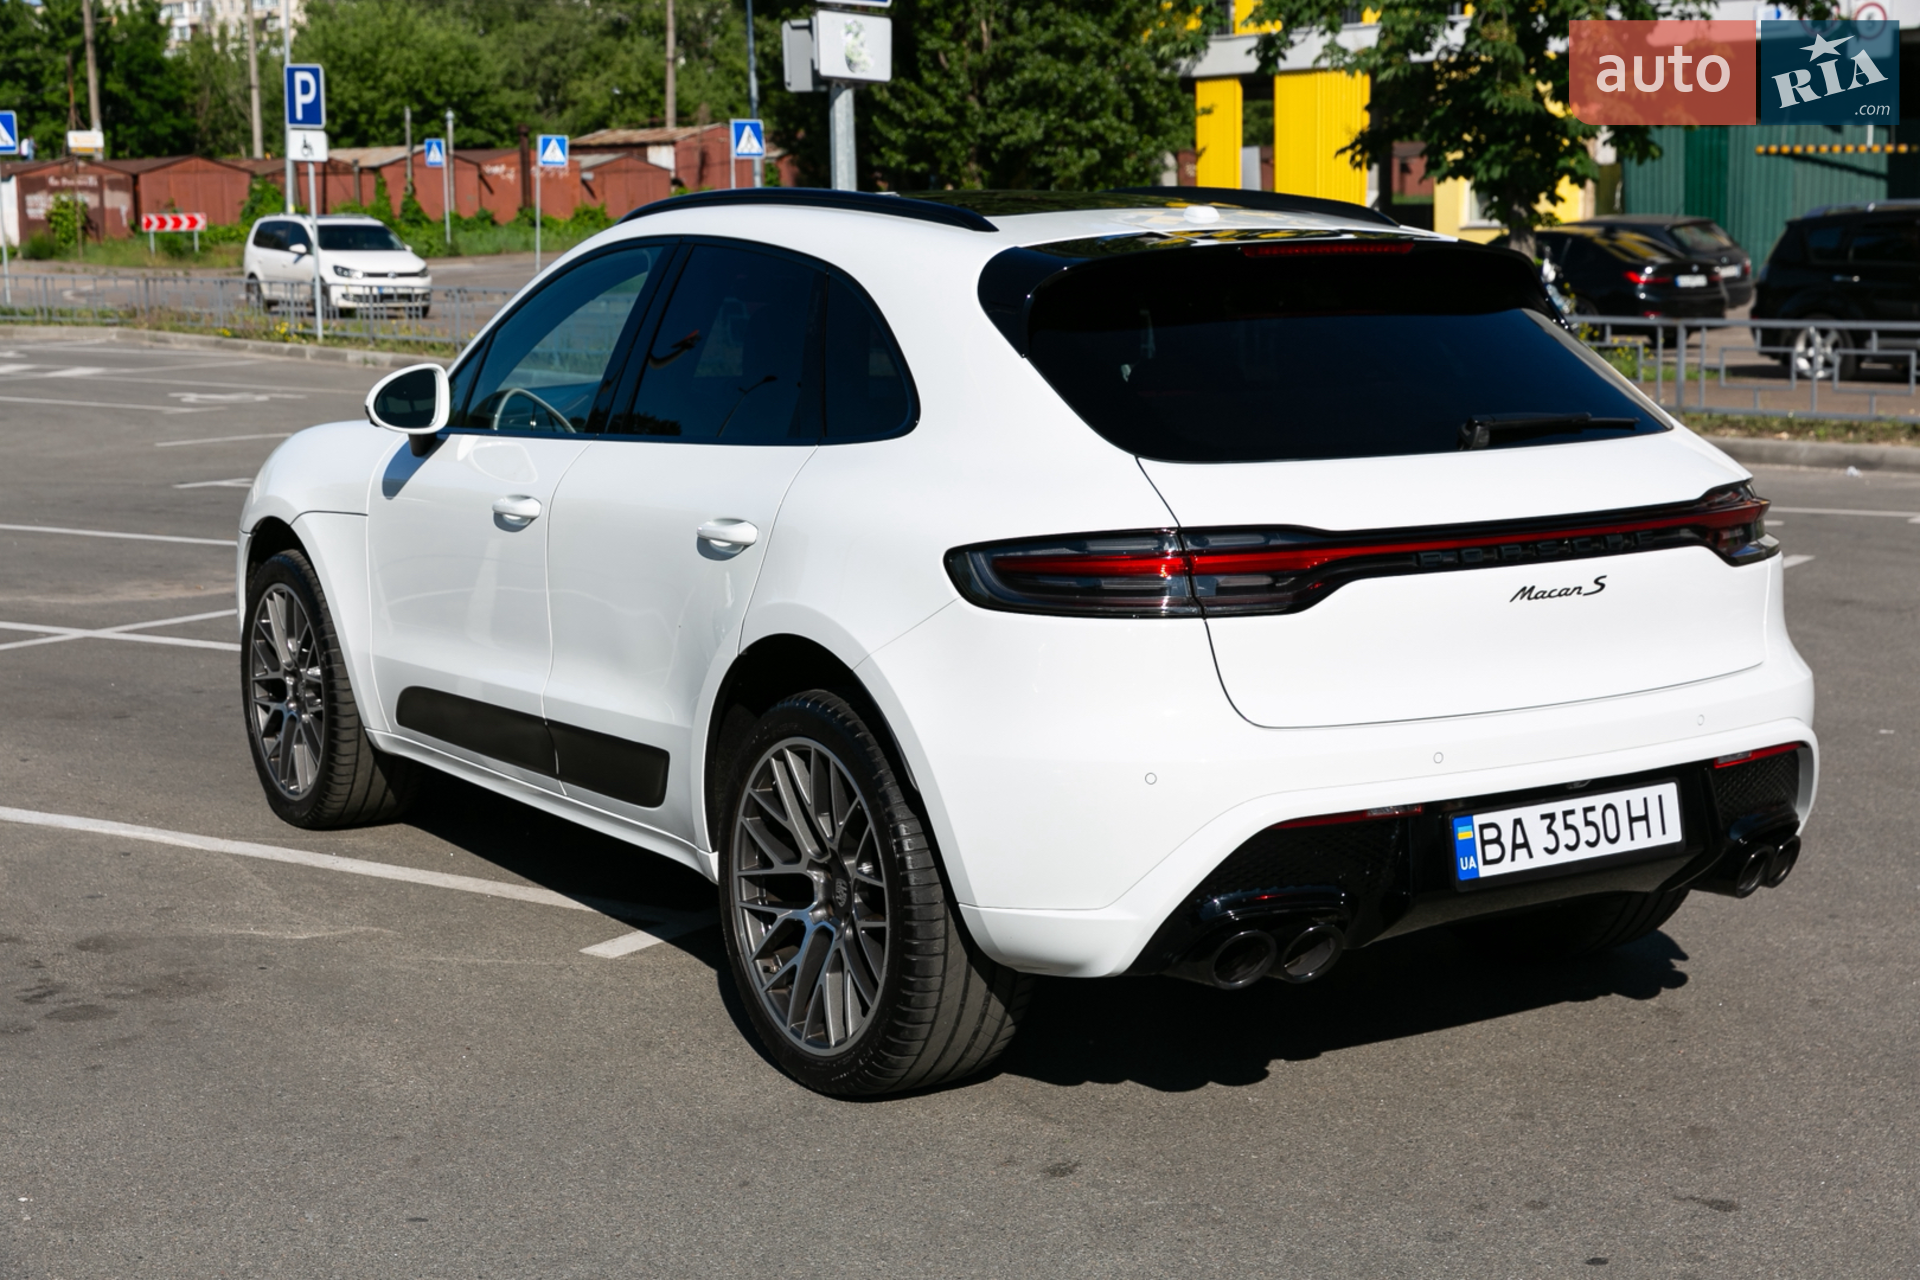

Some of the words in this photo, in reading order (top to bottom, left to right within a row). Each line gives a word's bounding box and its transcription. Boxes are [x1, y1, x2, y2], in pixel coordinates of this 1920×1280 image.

[294, 71, 317, 121] P
[1509, 585, 1583, 603] Macan
[1582, 575, 1608, 597] S
[1478, 817, 1534, 866] BA
[1540, 802, 1621, 856] 3550
[1626, 794, 1667, 842] HI
[1459, 855, 1478, 871] UA
